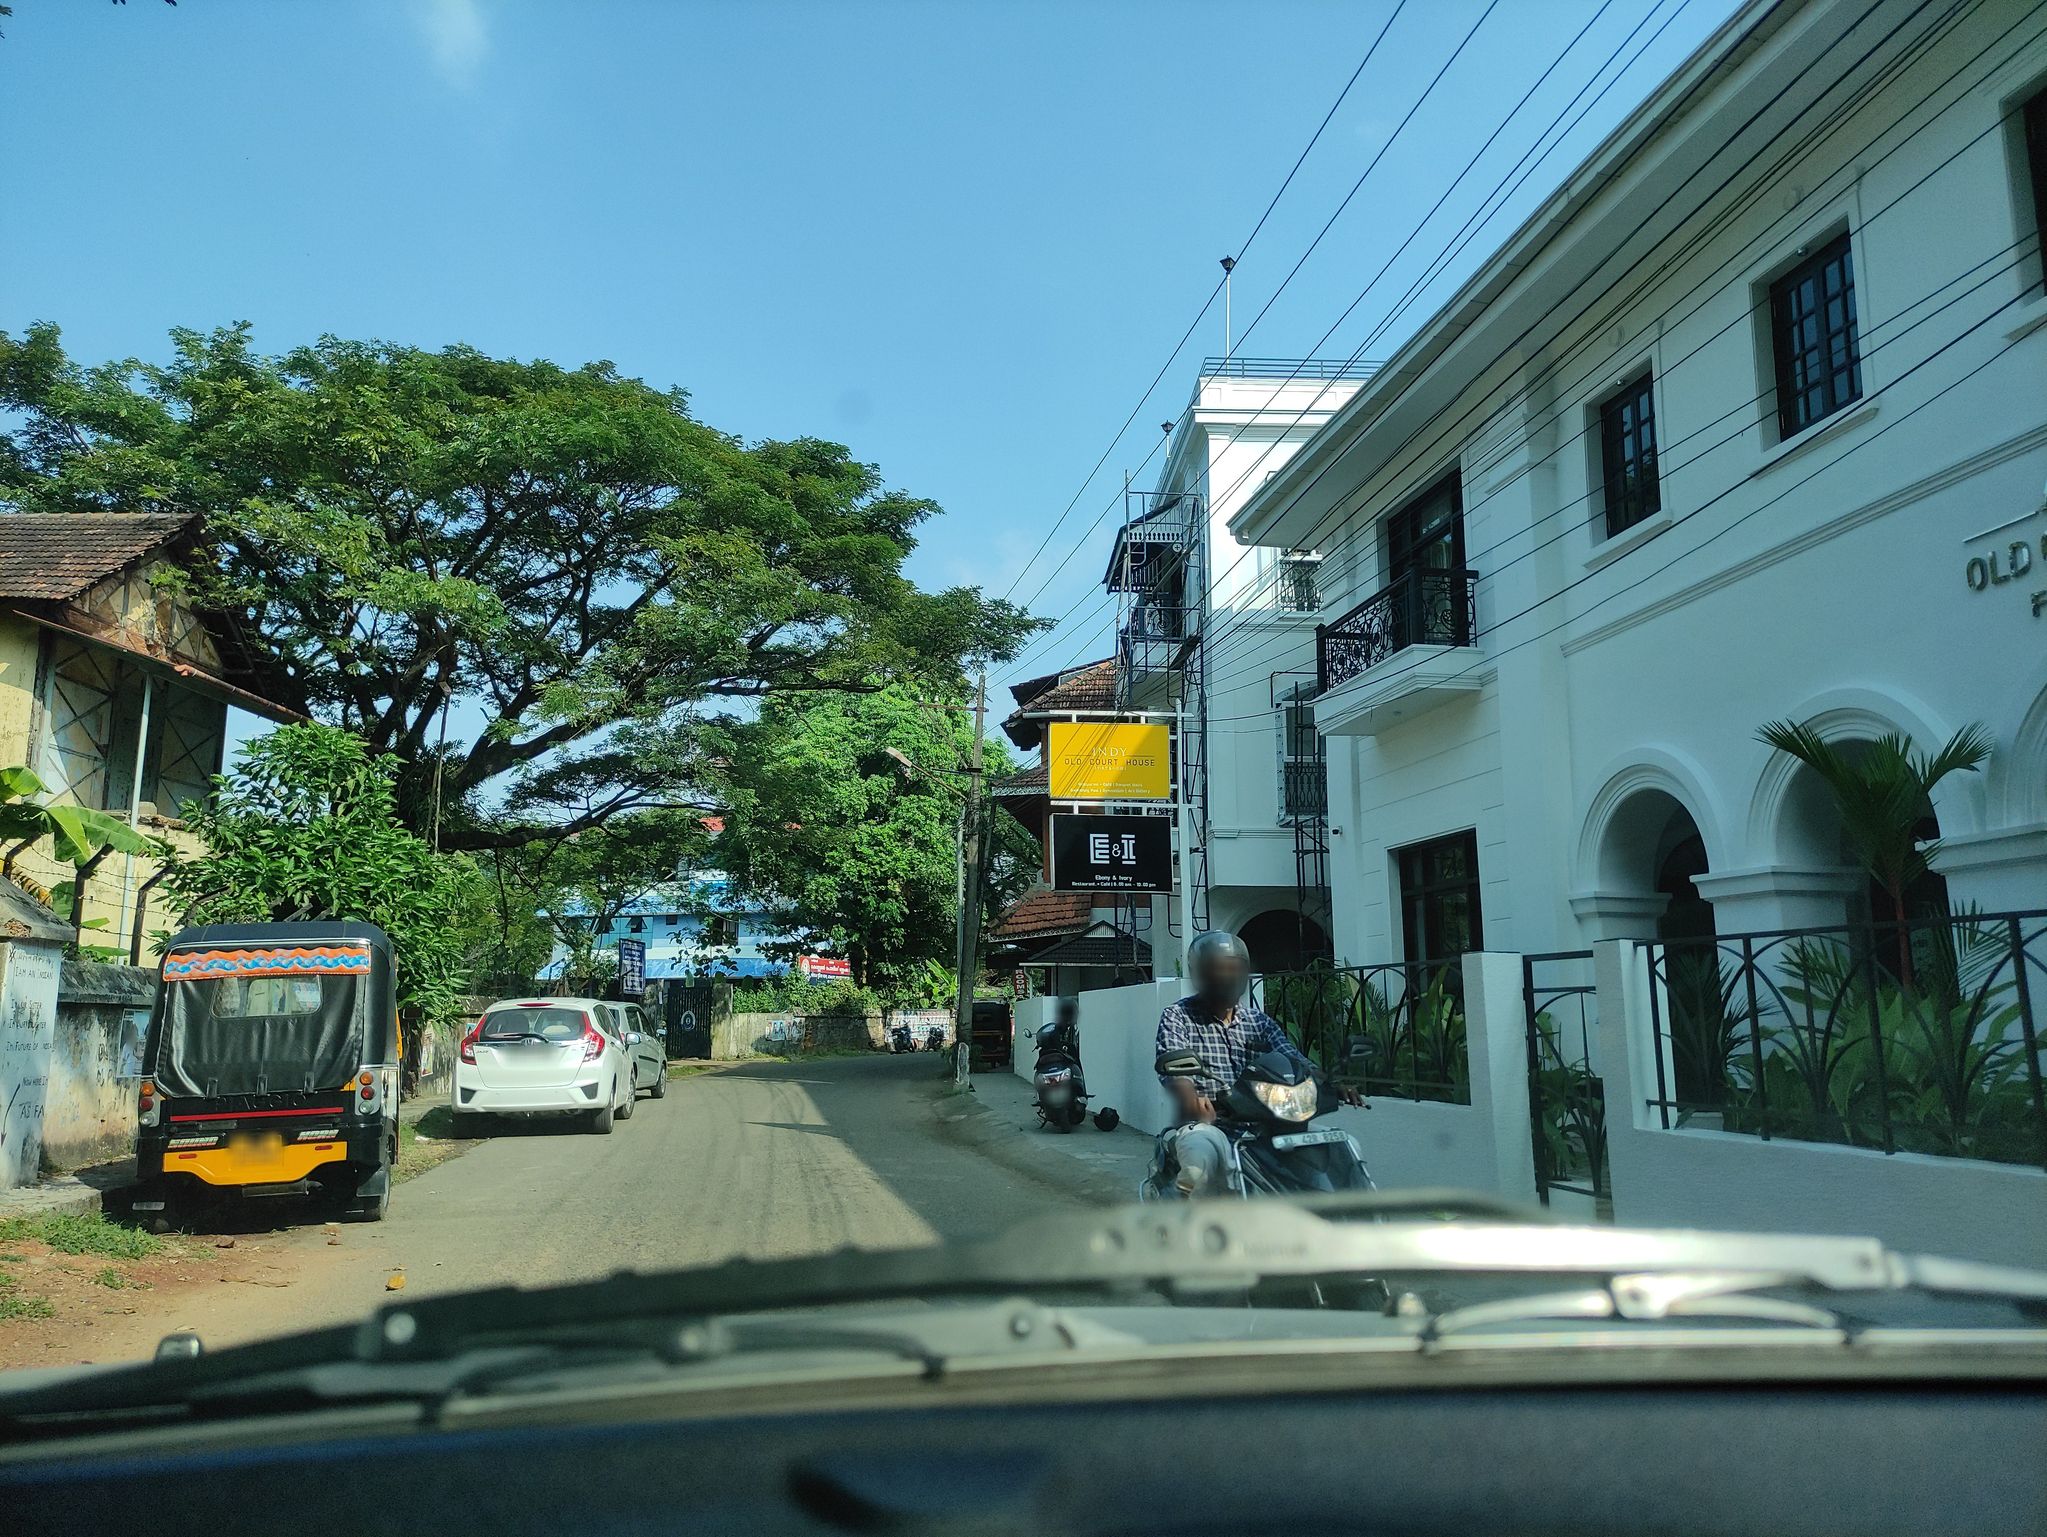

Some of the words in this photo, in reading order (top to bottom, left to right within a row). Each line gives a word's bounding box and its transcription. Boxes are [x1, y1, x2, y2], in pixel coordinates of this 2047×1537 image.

[1966, 541, 2031, 591] OLD
[1064, 758, 1082, 766] OLD
[1089, 758, 1118, 766] COURT
[1126, 759, 1155, 767] HOUSE
[1095, 874, 1111, 882] Ebony
